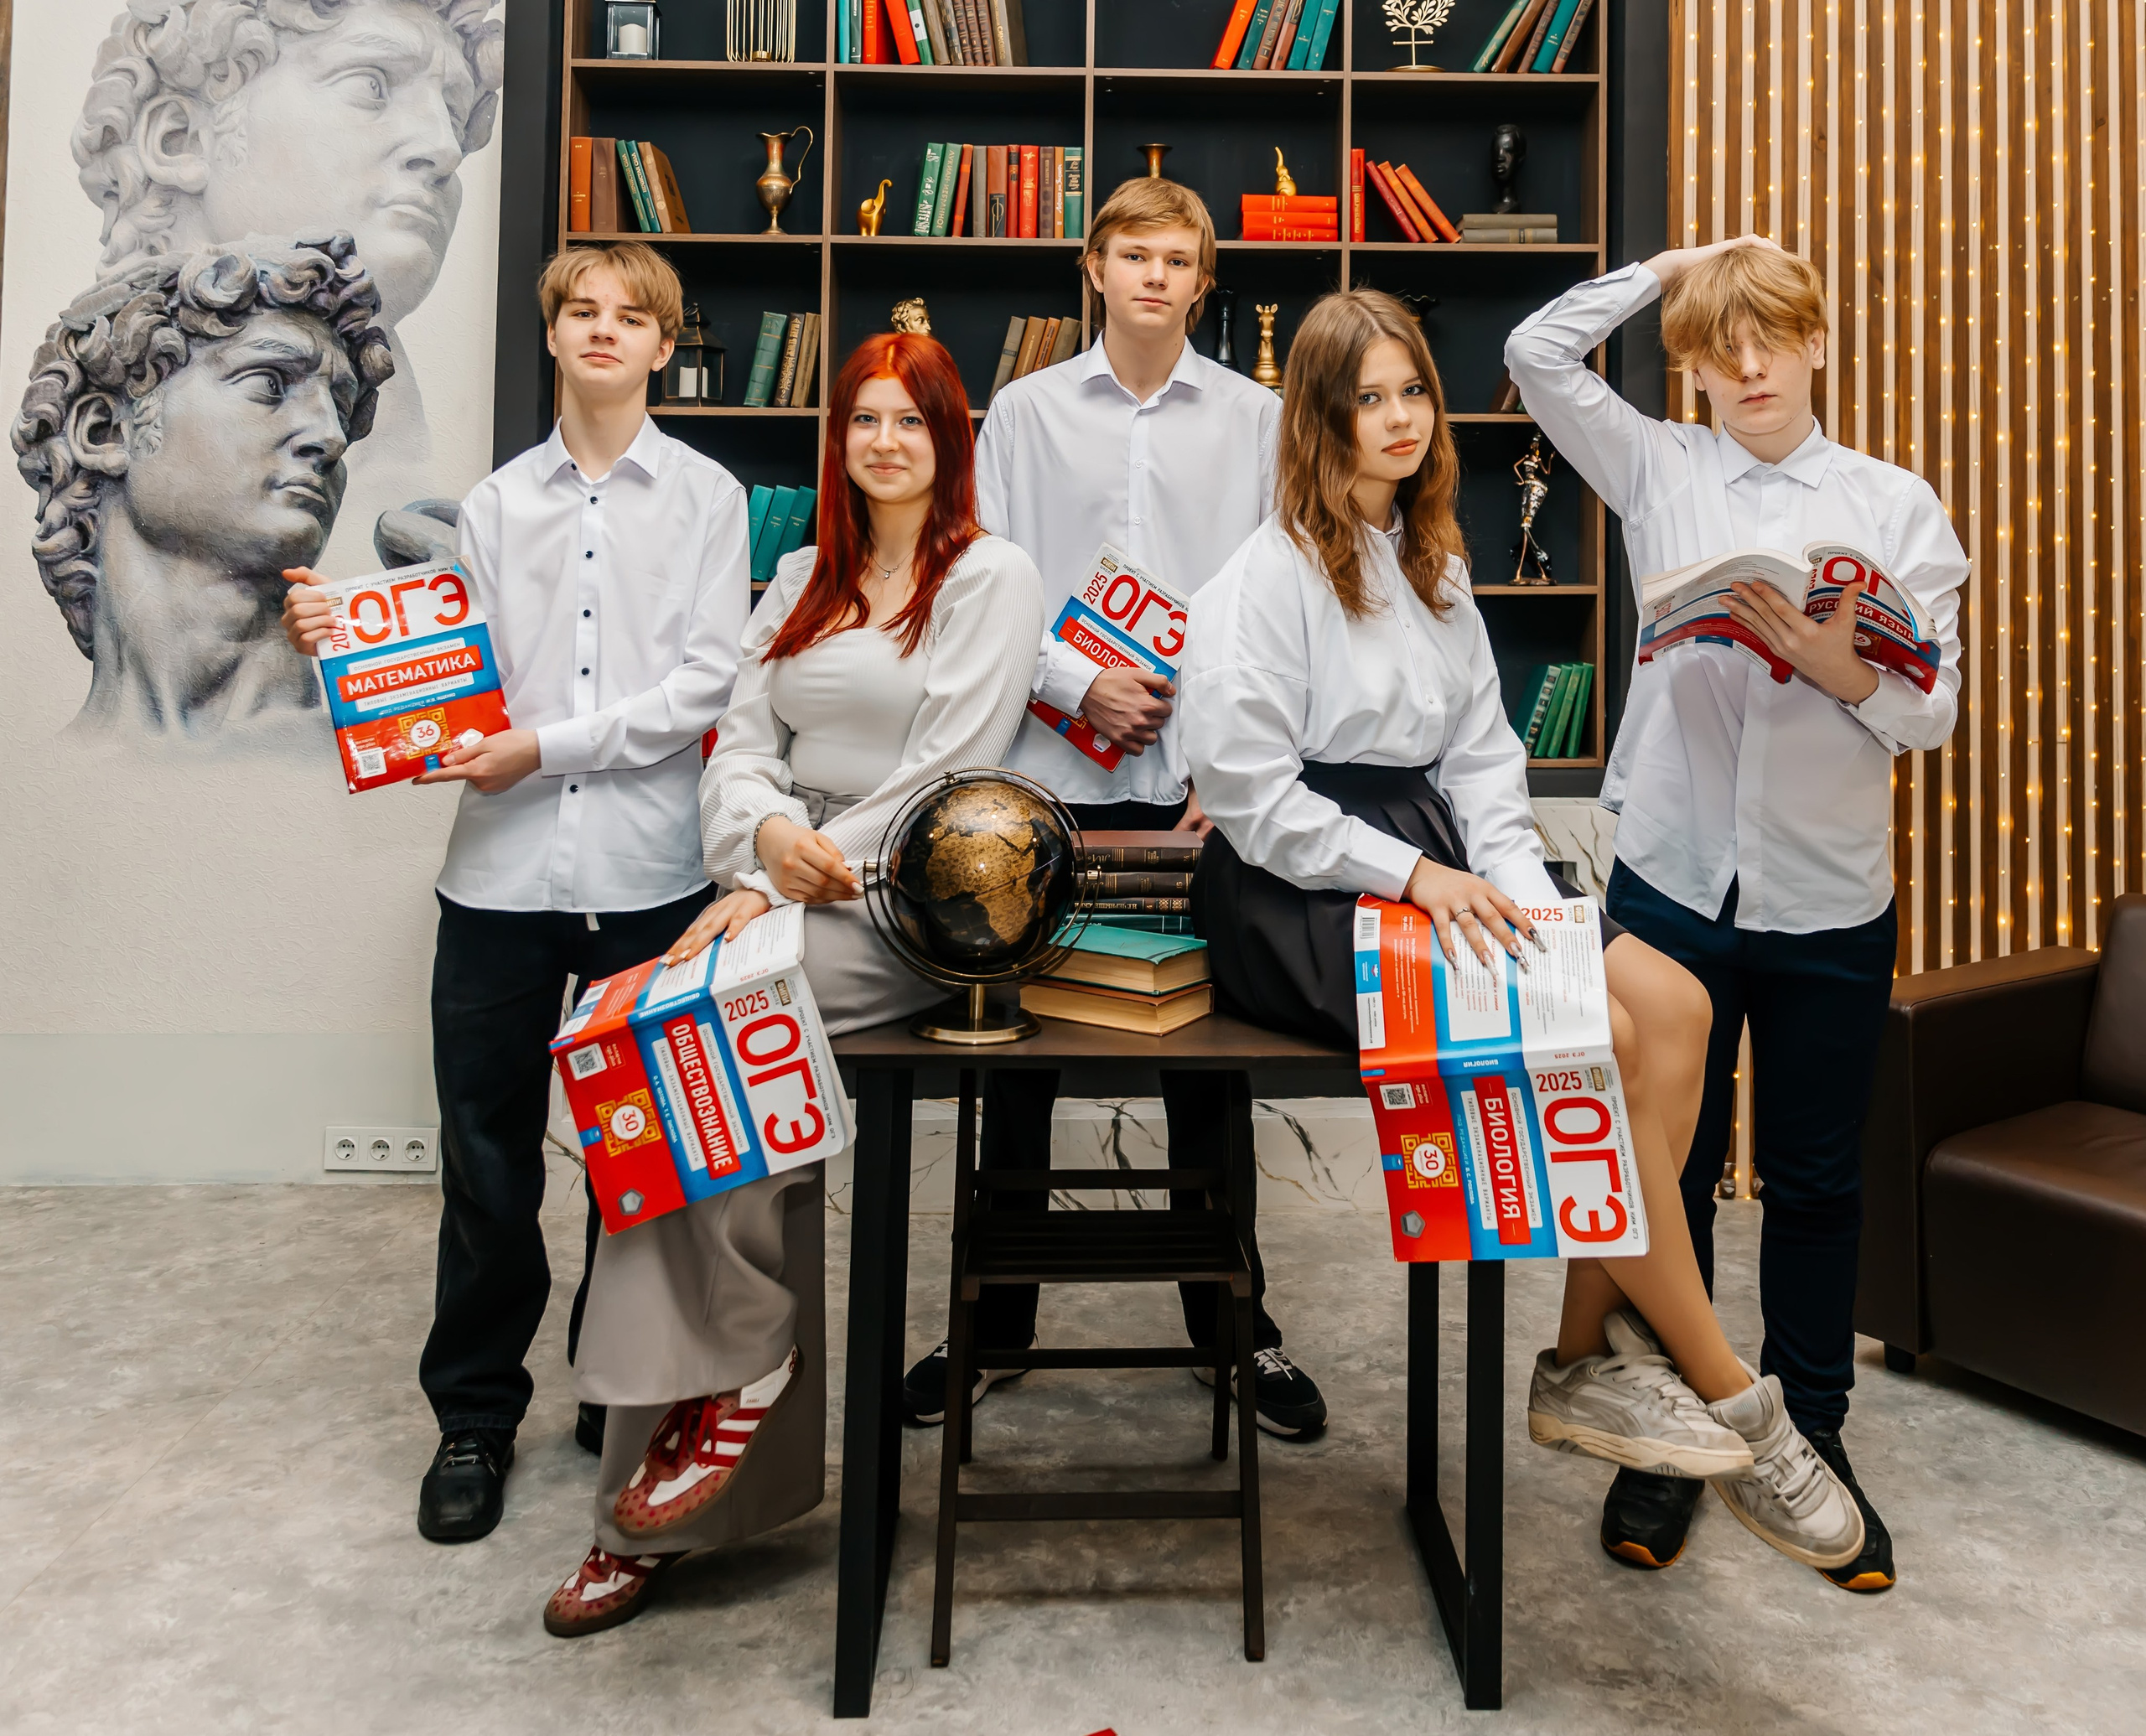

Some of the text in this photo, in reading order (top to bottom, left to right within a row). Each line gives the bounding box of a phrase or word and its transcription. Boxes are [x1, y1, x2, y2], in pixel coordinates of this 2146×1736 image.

[371, 578, 396, 587] УЧАСТИЕМ
[397, 569, 437, 581] РАЗРАБОТЧИКОВ
[1083, 572, 1108, 605] 2025
[1139, 575, 1158, 590] УЧАСТИЕМ
[1157, 585, 1185, 609] РАЗРАБОТЧИКОВ
[350, 573, 470, 644] ОГЭ
[1102, 574, 1188, 657] ОГЭ
[354, 642, 462, 671] ОСНОВНОЙ ГОСУДАРСТВЕННЫЙ ЭКЗАМЕН
[1073, 630, 1131, 670] БИОЛОГ
[1081, 618, 1152, 671] ОСНОВНОЙ ГОСУДАРСТВЕННЫЙ ЭКЗАМЕН
[346, 652, 477, 697] МАТЕМАТИКА
[363, 677, 468, 707] ТИПОВЫЕ ЭКЗАМЕНАЦИОННЫЕ ВАРИАНТЫ
[416, 724, 435, 738] 36
[1521, 908, 1563, 921] 2025
[639, 992, 700, 1018] ОБЩЕСТВОЗНАНИЕ
[724, 989, 770, 1023] 2025
[776, 981, 790, 1005] ФИПИ
[797, 1006, 807, 1028] ПРОЕКТ
[806, 1034, 817, 1065] УЧАСТИЕМ
[814, 1065, 830, 1112] РАЗРАБОТЧИКОВ
[1463, 1059, 1499, 1068] БИОЛОГИЯ
[671, 1023, 733, 1171] ОБЩЕСТВОЗНАНИЕ
[702, 1028, 744, 1149] ОСНОВНОЙ ГОСУДАРСТВЕННЫЙ ЭКЗАМЕН
[736, 1013, 826, 1154] ОГЭ
[1536, 1070, 1583, 1092] 2025
[622, 1109, 639, 1132] 30
[661, 1045, 700, 1162] ТИПОВЫЕ ЭКЗАМЕНАЦИОННЫЕ ВАРИАНТЫ
[1423, 1150, 1439, 1171] 30
[1467, 1097, 1491, 1221] ТИПОВЫЕ ЭКЗАМЕНАЦИОННЫЕ ВАРИАНТЫ
[1485, 1097, 1521, 1219] БИОЛОГИЯ
[1511, 1092, 1537, 1221] ОСНОВНОЙ ГОСУДАРСТВЕННЫЙ ЭКЗАМЕН
[1543, 1096, 1628, 1243] ОГЭ
[1611, 1096, 1620, 1117] ПРОЕКТ
[1616, 1126, 1626, 1157] УЧАСТИЕМ
[1622, 1159, 1635, 1208] РАЗРАБОТЧИКОВ
